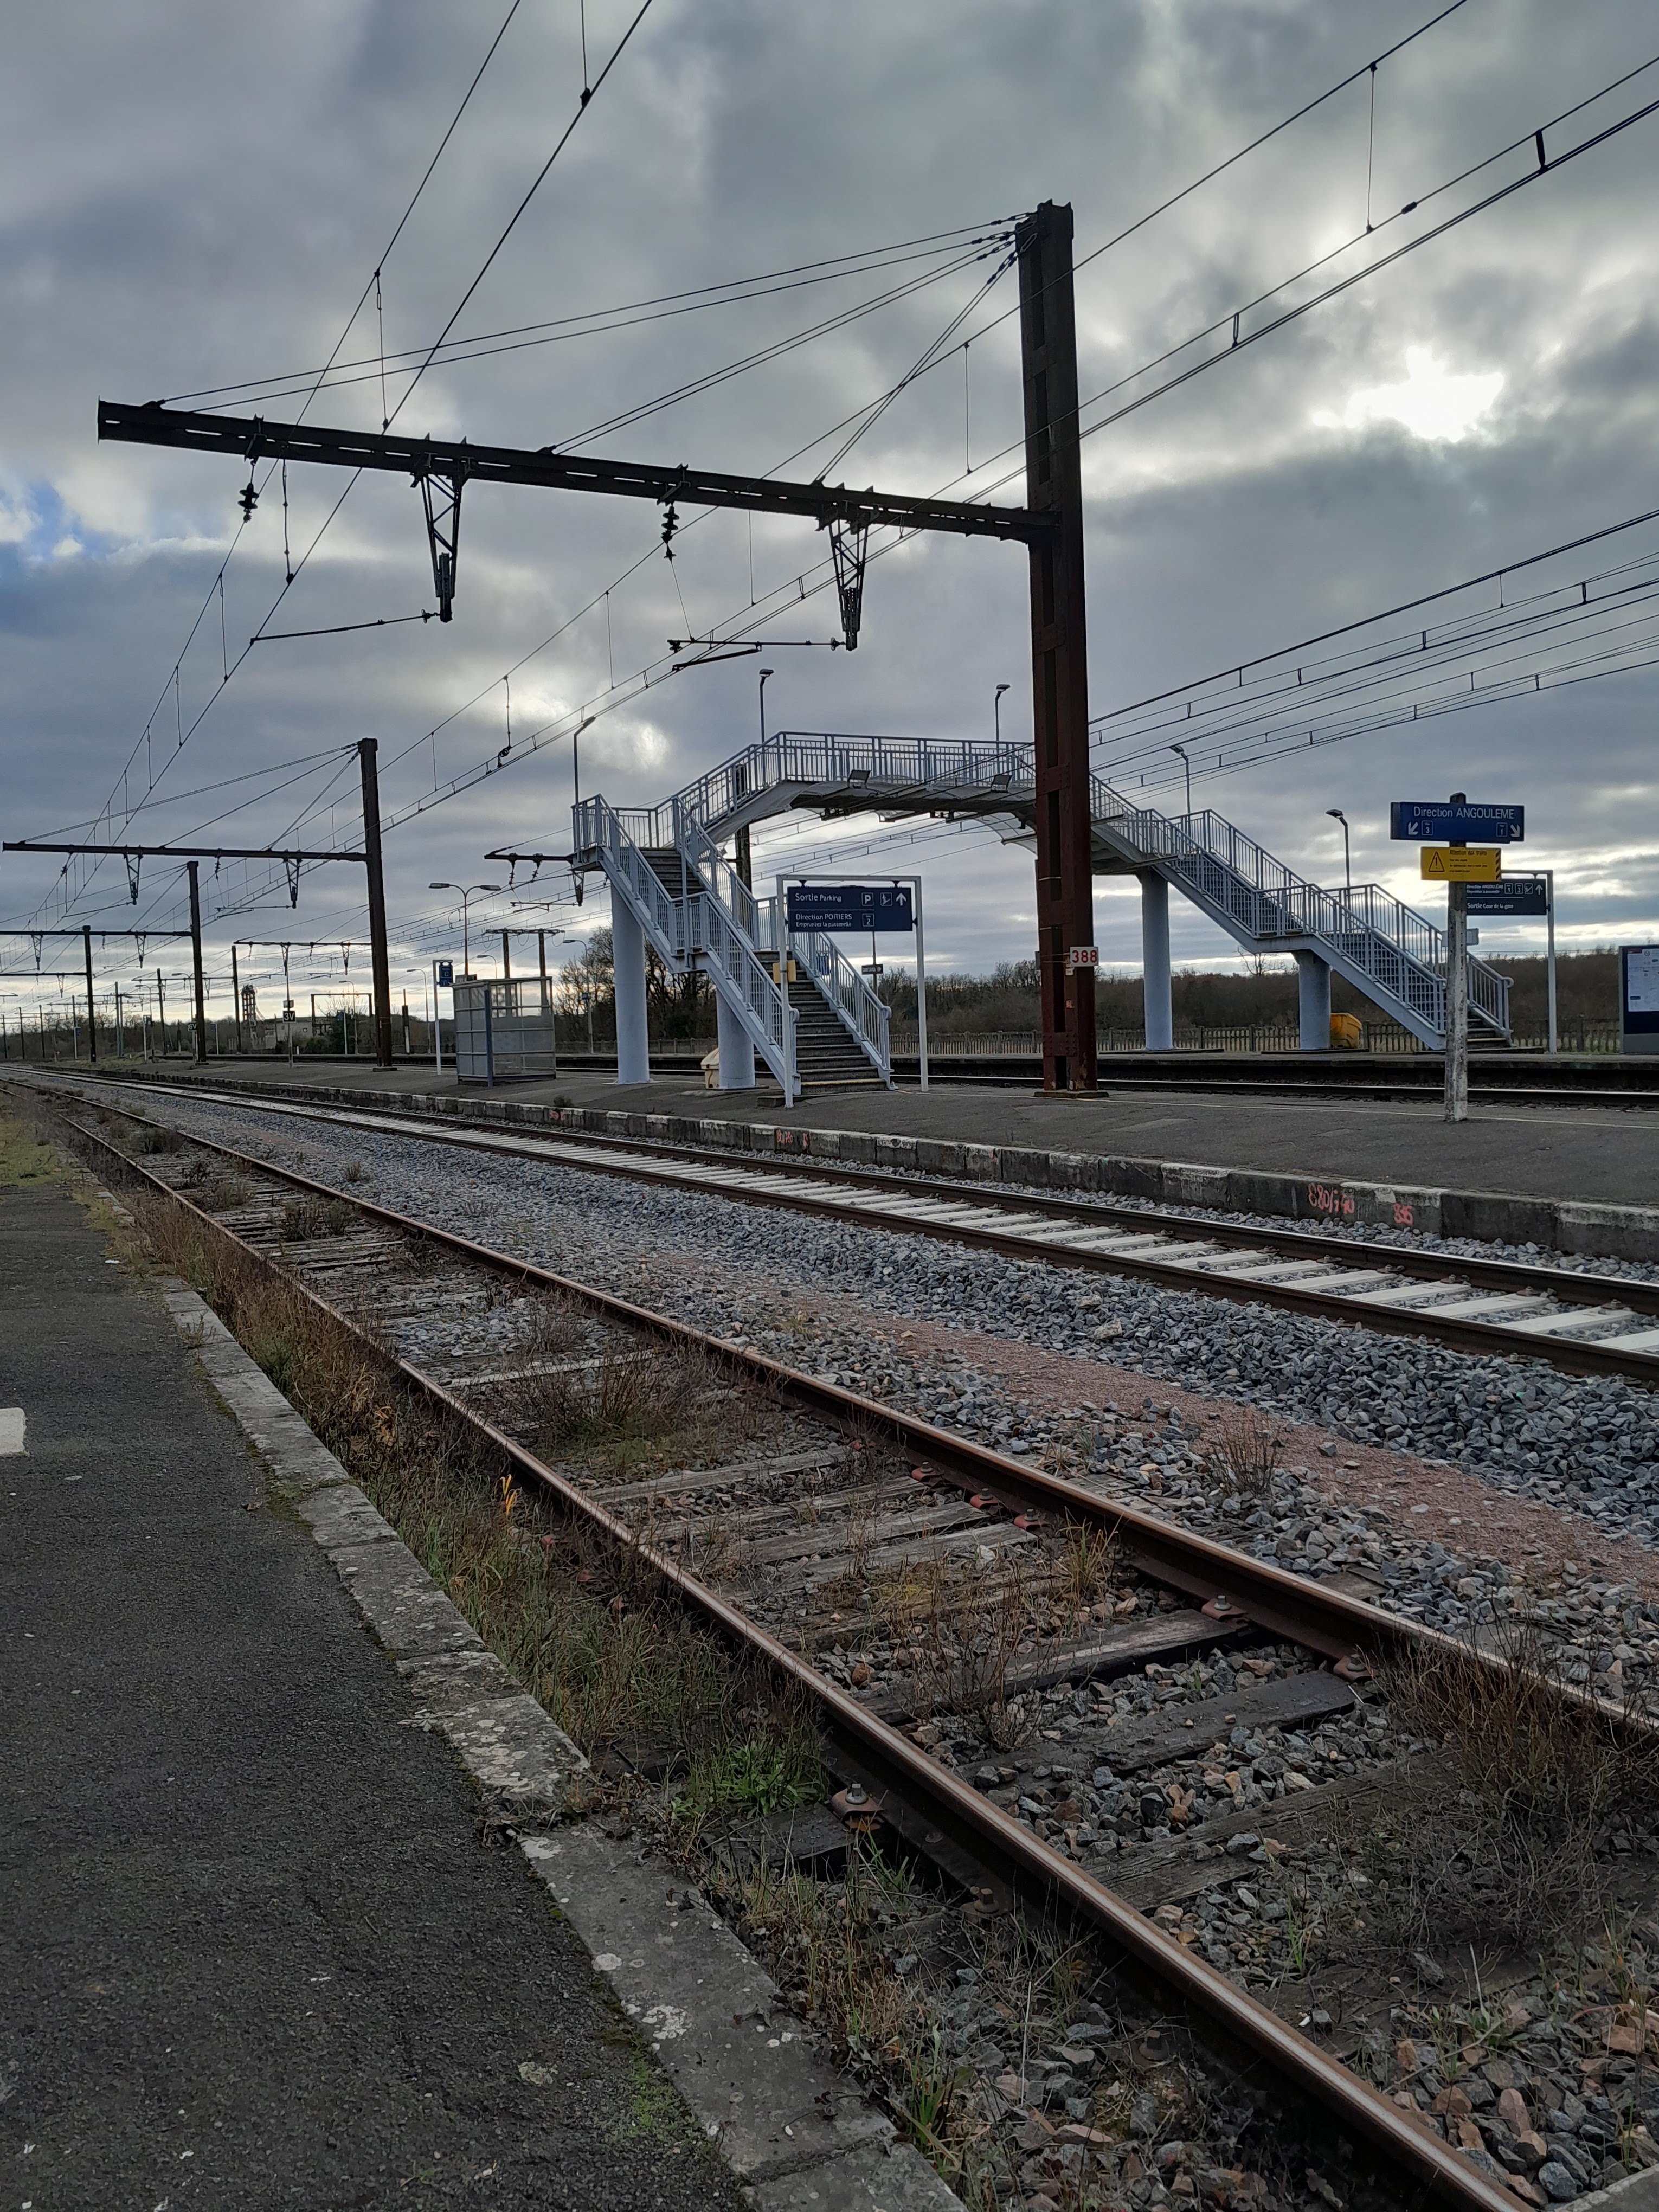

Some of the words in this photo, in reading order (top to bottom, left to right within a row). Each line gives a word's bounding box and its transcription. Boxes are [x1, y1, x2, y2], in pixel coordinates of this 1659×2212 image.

[1413, 806, 1453, 818] Direction
[1456, 807, 1515, 819] ANGOULEME
[795, 893, 819, 901] Sortie
[820, 894, 842, 903] Parking
[864, 895, 871, 904] P
[1071, 950, 1098, 963] 388
[284, 1012, 294, 1021] 3V
